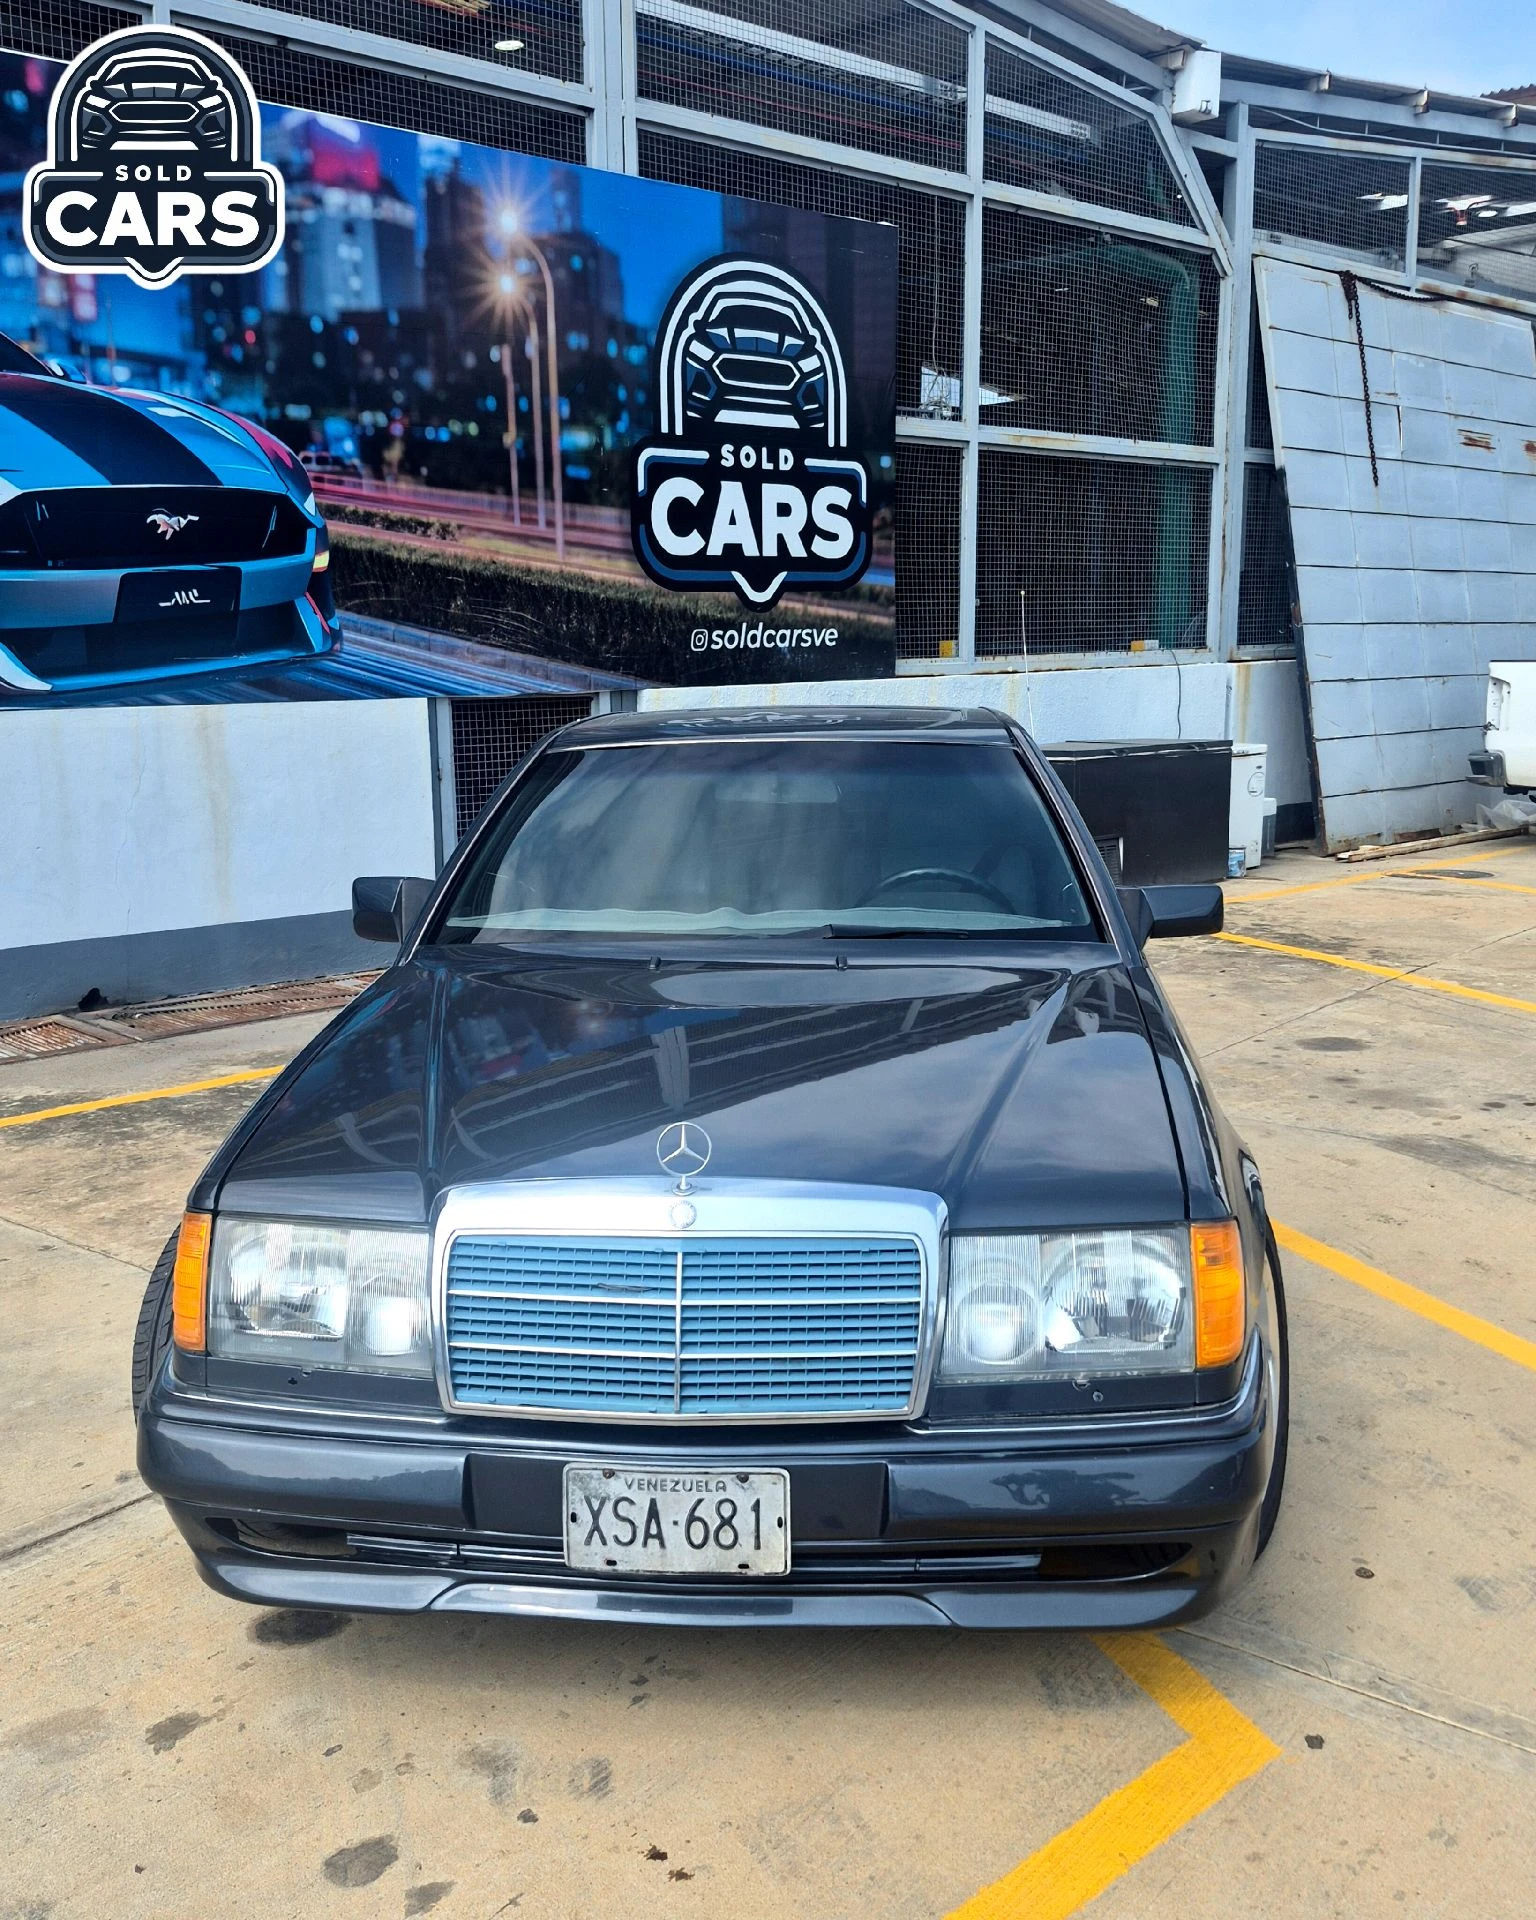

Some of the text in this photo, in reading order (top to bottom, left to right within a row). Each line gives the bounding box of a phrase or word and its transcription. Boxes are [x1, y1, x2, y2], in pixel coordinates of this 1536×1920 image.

[720, 443, 794, 471] SOLD
[651, 476, 854, 559] CARS
[710, 622, 839, 649] soldcarsve
[625, 1478, 727, 1492] VENEZUELA
